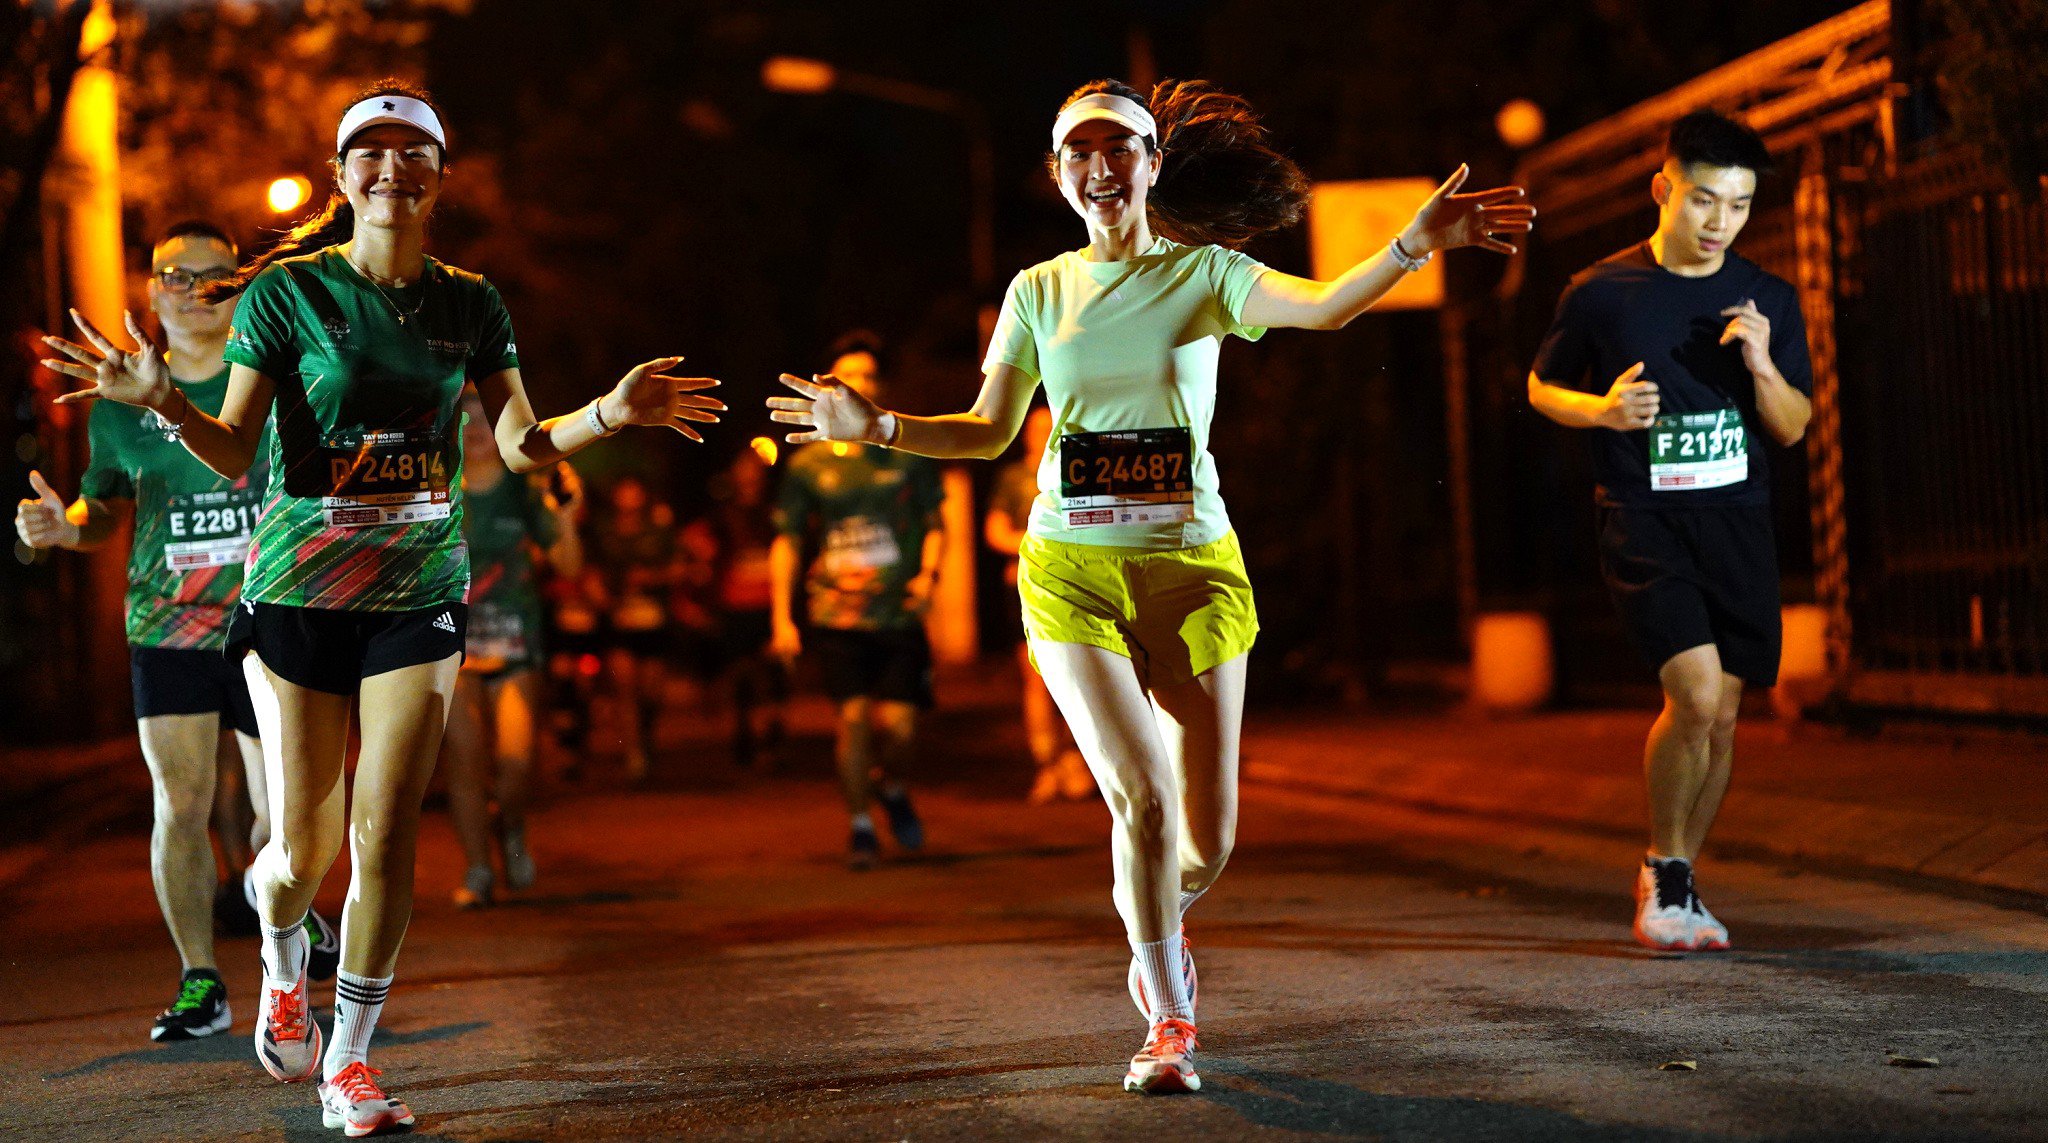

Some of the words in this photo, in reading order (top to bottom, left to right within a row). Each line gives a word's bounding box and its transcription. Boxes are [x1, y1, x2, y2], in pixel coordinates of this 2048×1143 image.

[1657, 432, 1673, 457] F
[1679, 425, 1744, 456] 21379
[331, 458, 351, 485] D
[361, 451, 445, 483] 24814
[1068, 458, 1086, 485] C
[1095, 453, 1183, 483] 24687
[433, 491, 447, 499] 338
[170, 512, 186, 537] E
[191, 503, 260, 535] 22811
[432, 621, 456, 633] adidas
